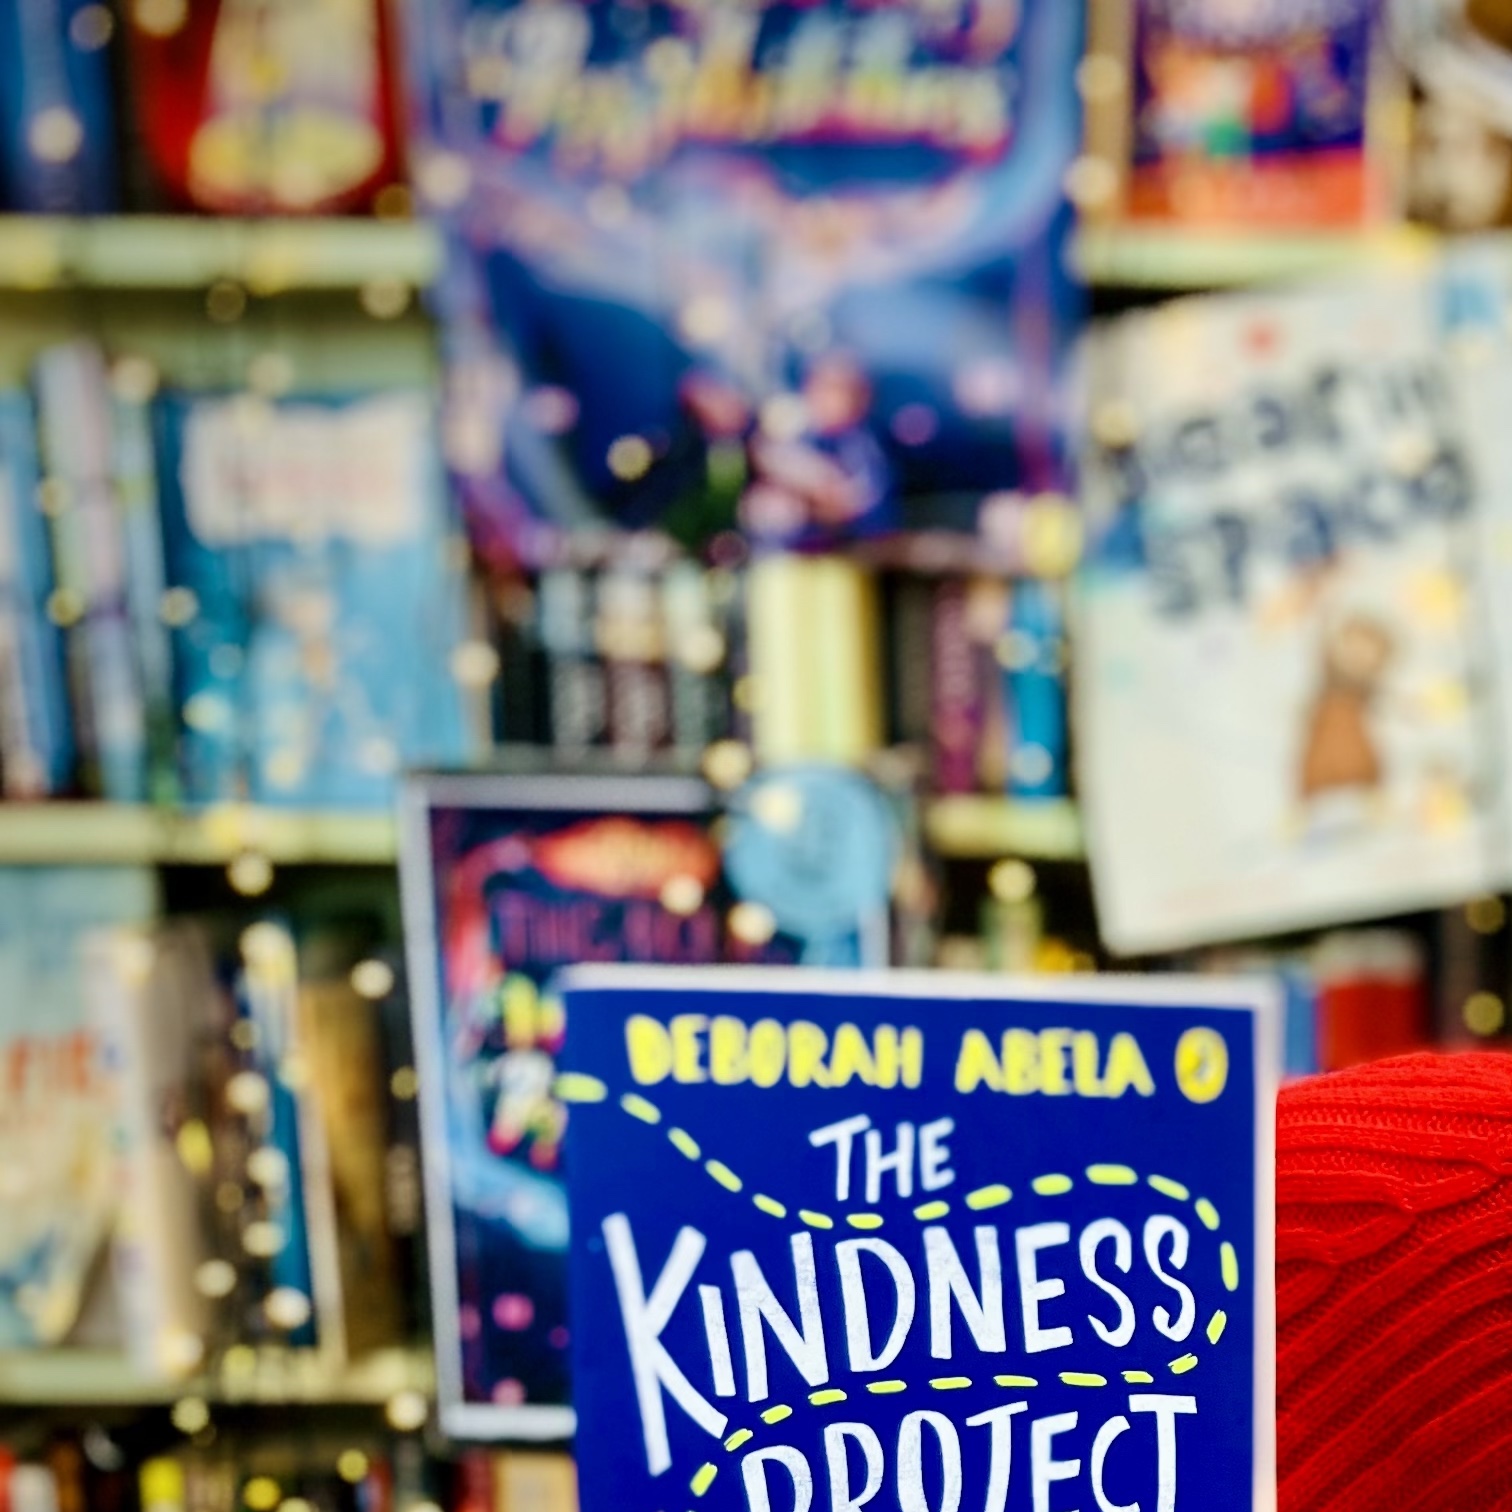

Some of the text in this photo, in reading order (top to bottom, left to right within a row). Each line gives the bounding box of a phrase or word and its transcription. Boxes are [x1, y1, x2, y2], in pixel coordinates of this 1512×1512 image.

[626, 1014, 1156, 1099] DEBORAH ABELA
[808, 1114, 956, 1204] THE
[601, 1213, 1197, 1478] KINDNESS
